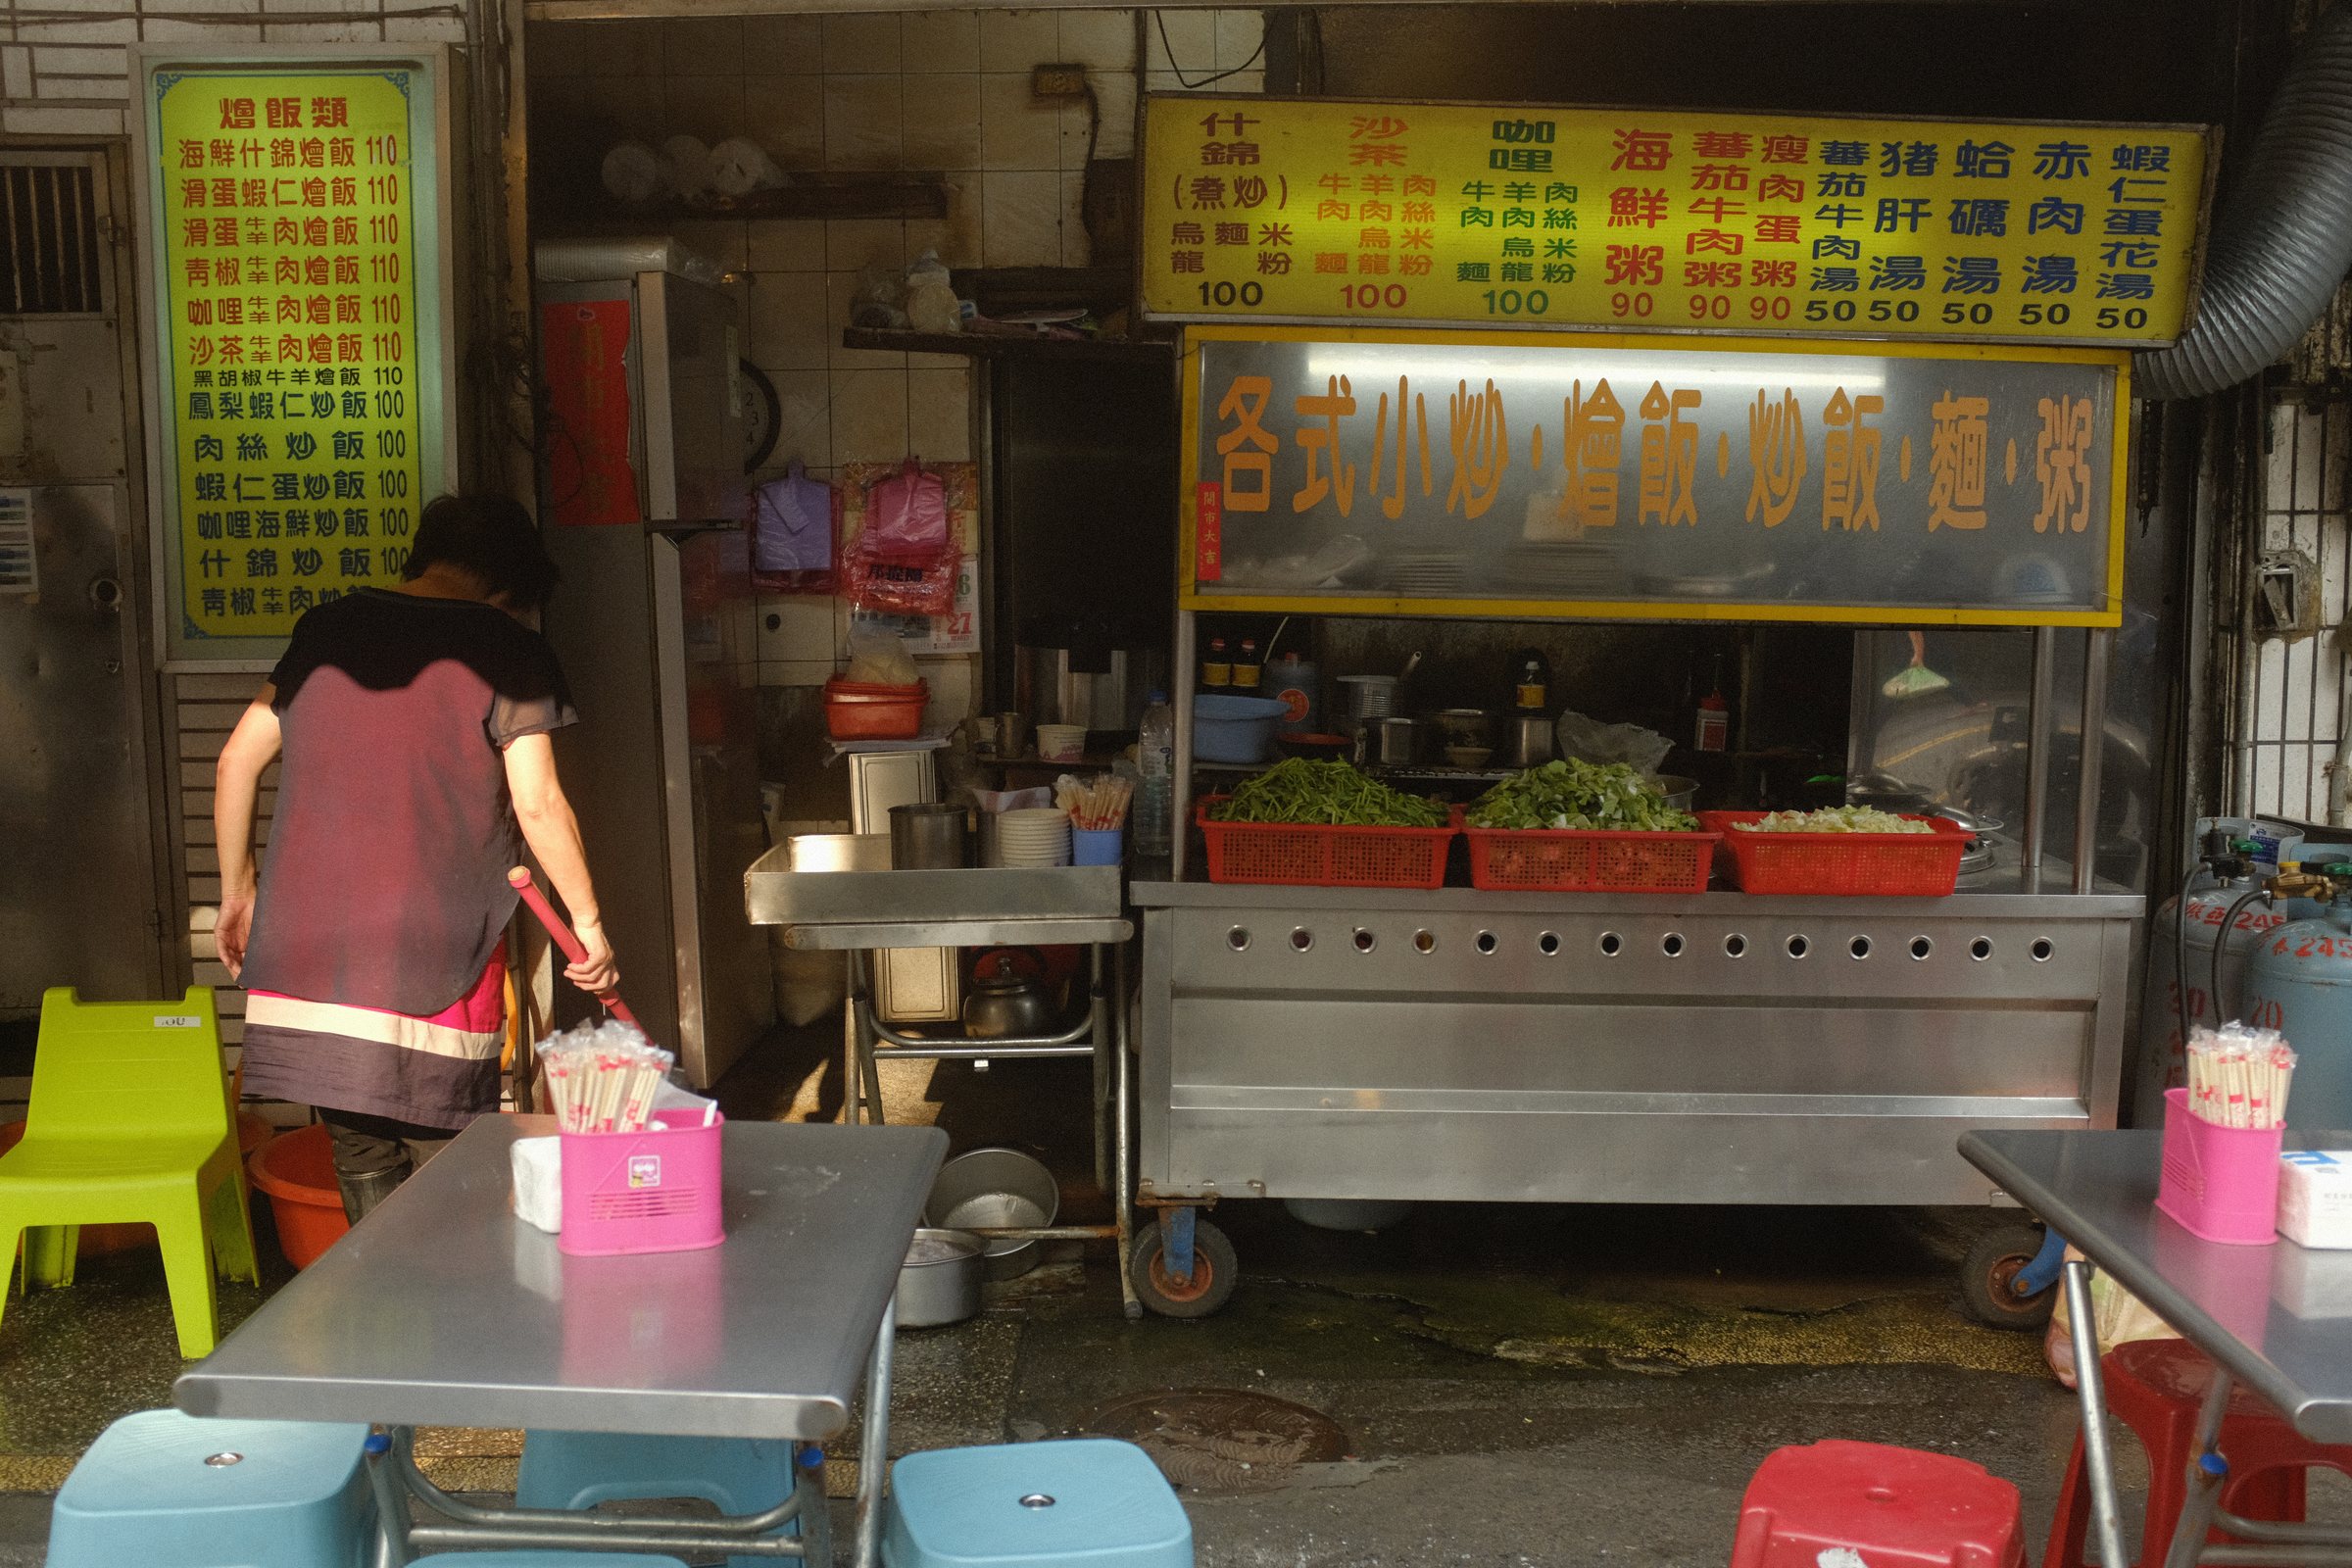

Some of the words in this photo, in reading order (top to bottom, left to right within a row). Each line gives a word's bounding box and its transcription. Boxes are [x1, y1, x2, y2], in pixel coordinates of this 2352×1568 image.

[219, 97, 349, 129] 燴飯類
[178, 137, 356, 169] 海鮮什錦燴飯
[366, 134, 398, 166] 110
[1199, 113, 1261, 166] 什錦
[1348, 116, 1409, 168] 沙茶
[1489, 120, 1556, 172] 咖哩
[180, 176, 358, 208] 滑蛋蝦仁燴飯
[368, 173, 398, 205] 110
[1603, 128, 1673, 286] 海鮮粥
[1749, 134, 1810, 288] 瘦肉蛋粥
[2021, 140, 2091, 294] 赤肉湯
[2094, 144, 2171, 300] 蝦仁蛋花湯
[369, 213, 399, 245] 110
[370, 252, 400, 284] 110
[371, 293, 401, 324] 110
[1199, 281, 1263, 307] 100
[1340, 284, 1407, 309] 100
[1483, 289, 1548, 316] 100
[1611, 292, 1653, 318] 90
[1689, 295, 1731, 320] 90
[1749, 296, 1790, 320] 90
[1804, 300, 1856, 322] 50
[1867, 300, 1920, 322] 50
[1940, 303, 1993, 324] 50
[2018, 303, 2070, 325] 50
[2095, 307, 2147, 329] 50
[372, 330, 402, 363] 110
[373, 367, 403, 386] 110
[188, 390, 368, 420] 鳳梨蝦仁炒飯
[374, 389, 405, 419] 100
[194, 430, 366, 463] 肉絲炒飯
[376, 429, 406, 459] 100
[195, 469, 367, 503] 蝦仁蛋炒飯
[378, 469, 408, 498] 100
[198, 508, 370, 540] 咖哩海鮮炒飯
[379, 508, 409, 537] 100
[199, 547, 372, 578] 什錦炒飯
[381, 547, 410, 576] 100
